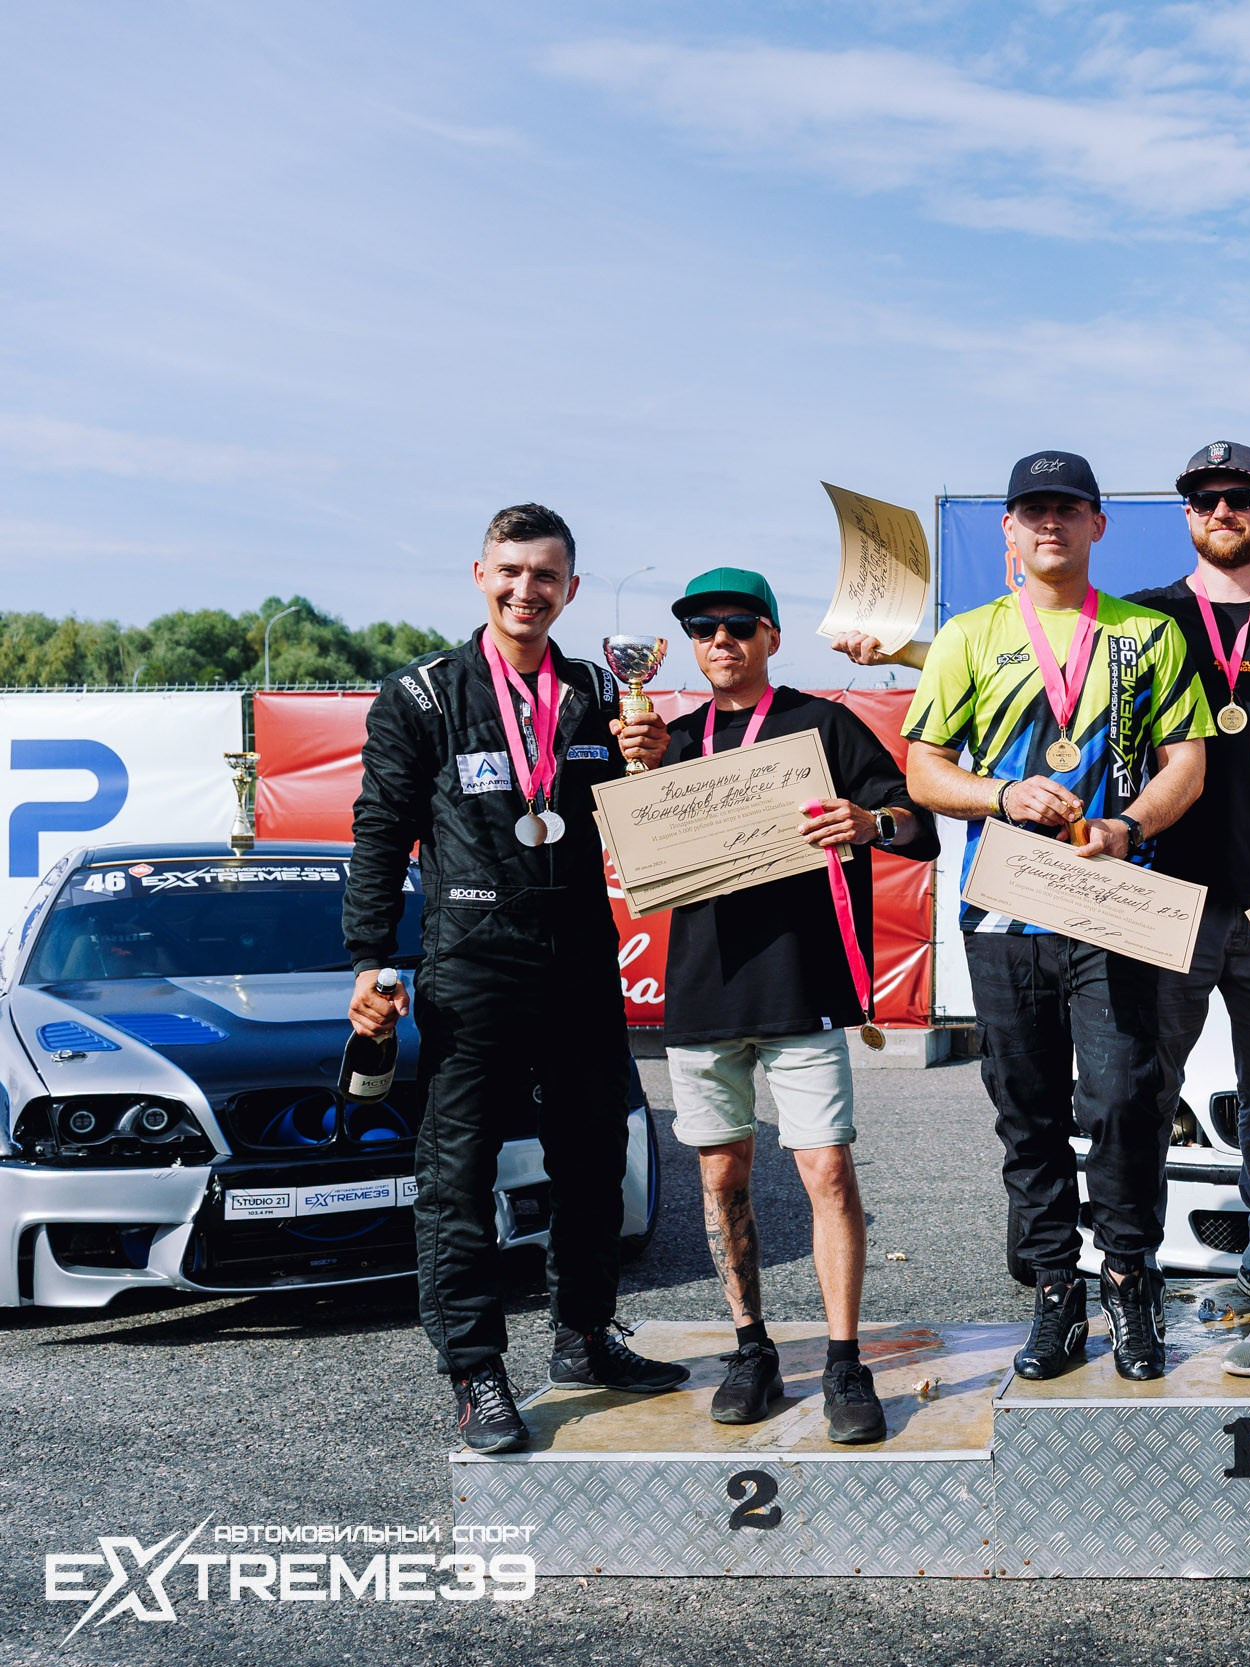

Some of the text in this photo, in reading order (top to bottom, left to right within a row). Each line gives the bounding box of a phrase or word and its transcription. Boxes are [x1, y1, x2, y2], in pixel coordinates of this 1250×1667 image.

[1110, 636, 1118, 661] СПОРТ
[1110, 636, 1138, 798] EXTREME39
[83, 871, 127, 893] 46
[142, 866, 341, 893] EXTREME39
[237, 1197, 286, 1206] STUDIO 21
[305, 1188, 390, 1211] EXTREME39
[727, 1469, 782, 1531] 2
